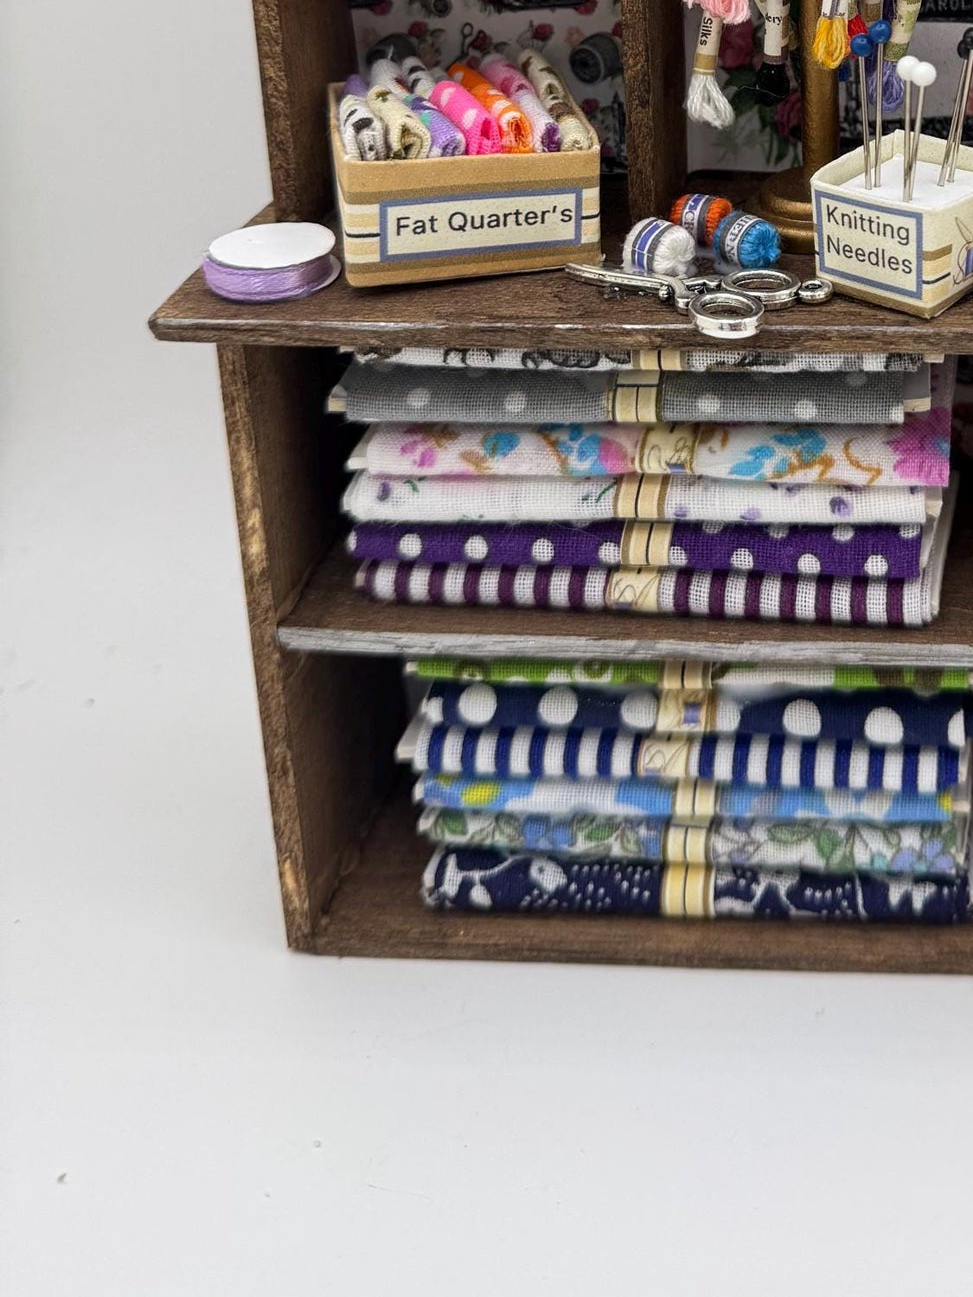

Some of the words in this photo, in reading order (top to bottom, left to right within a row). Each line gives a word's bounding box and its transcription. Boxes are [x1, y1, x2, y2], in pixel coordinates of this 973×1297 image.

[700, 16, 713, 47] Silks
[396, 215, 439, 237] Fat
[447, 203, 574, 234] Quarter's
[826, 204, 910, 246] Knitting
[826, 234, 913, 275] Needles
